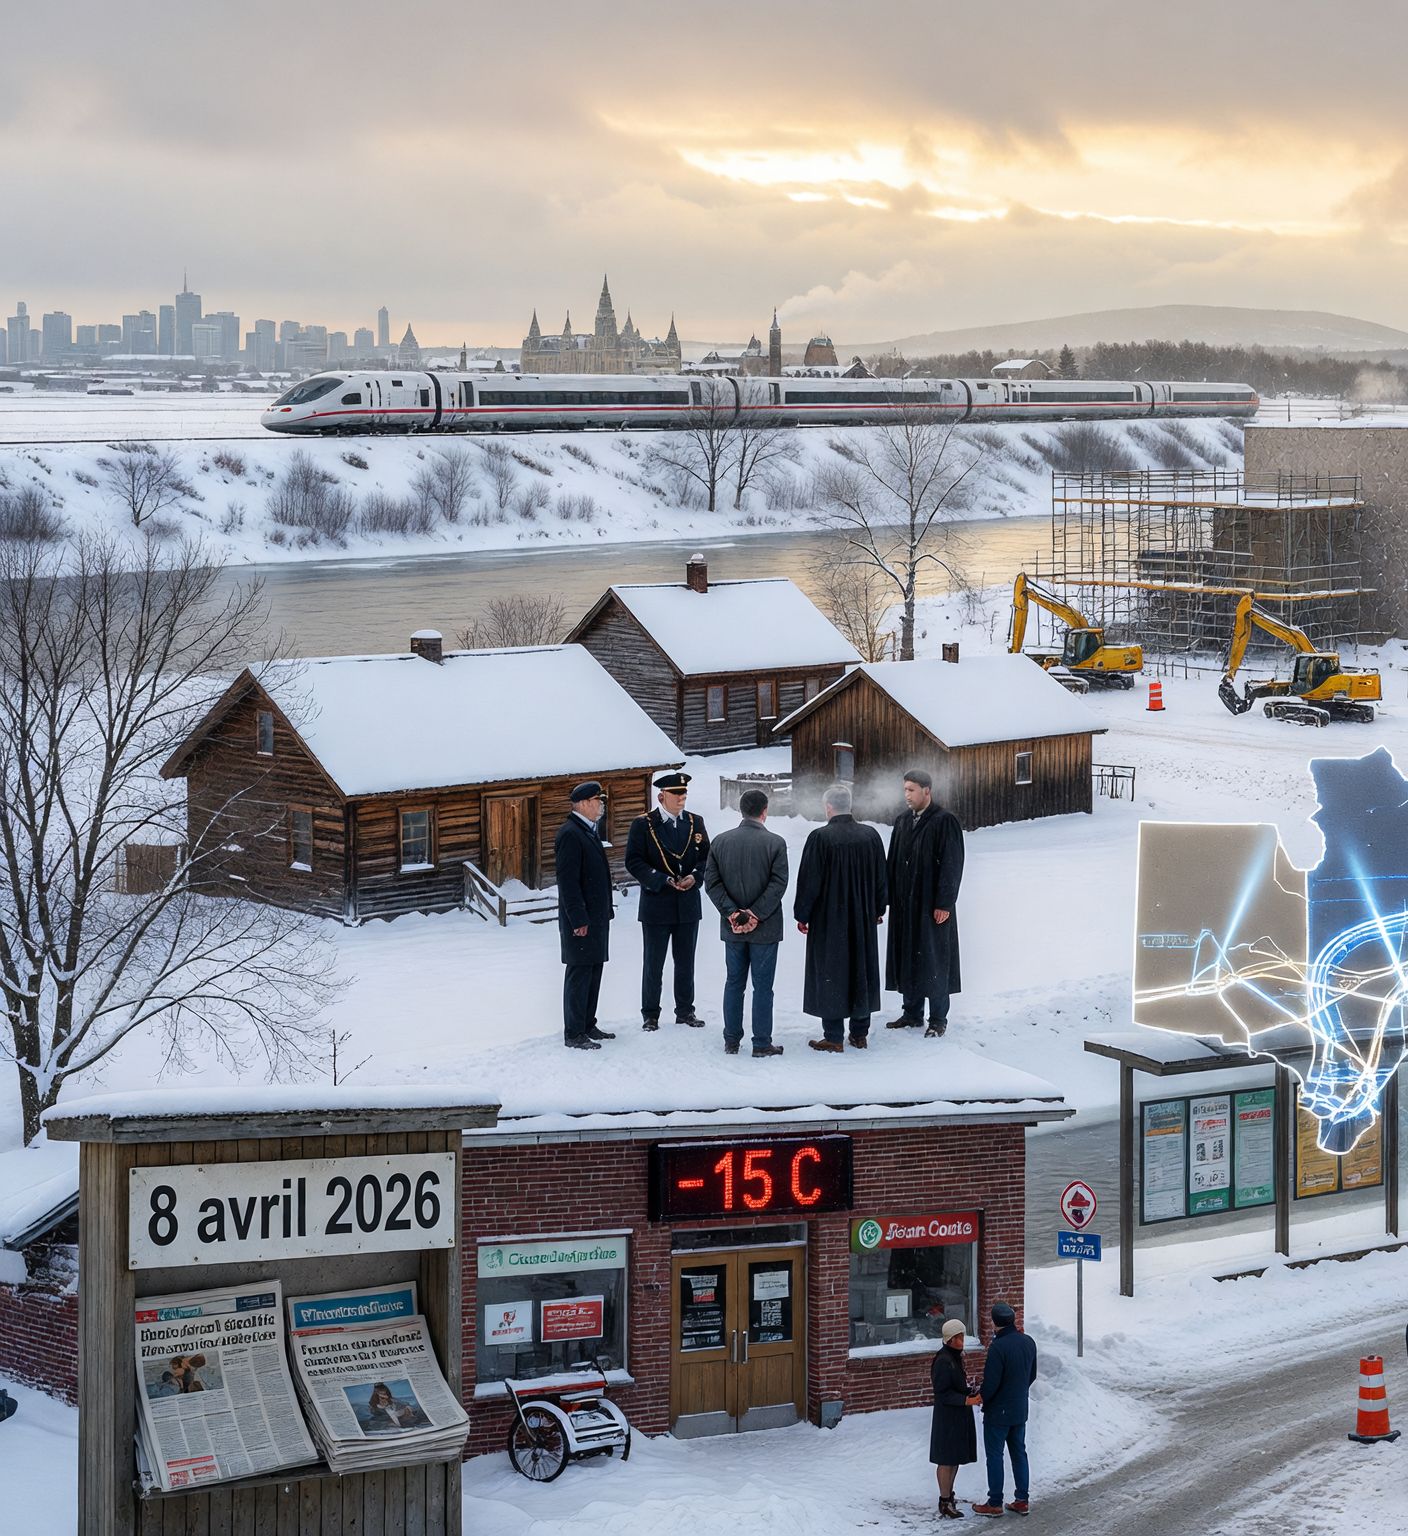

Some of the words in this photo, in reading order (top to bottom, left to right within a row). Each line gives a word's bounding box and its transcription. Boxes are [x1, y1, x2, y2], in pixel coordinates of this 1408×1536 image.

[148, 1184, 179, 1247] 8
[197, 1176, 307, 1244] avril
[324, 1170, 441, 1236] 2026
[678, 1147, 773, 1209] -15
[791, 1147, 822, 1205] C
